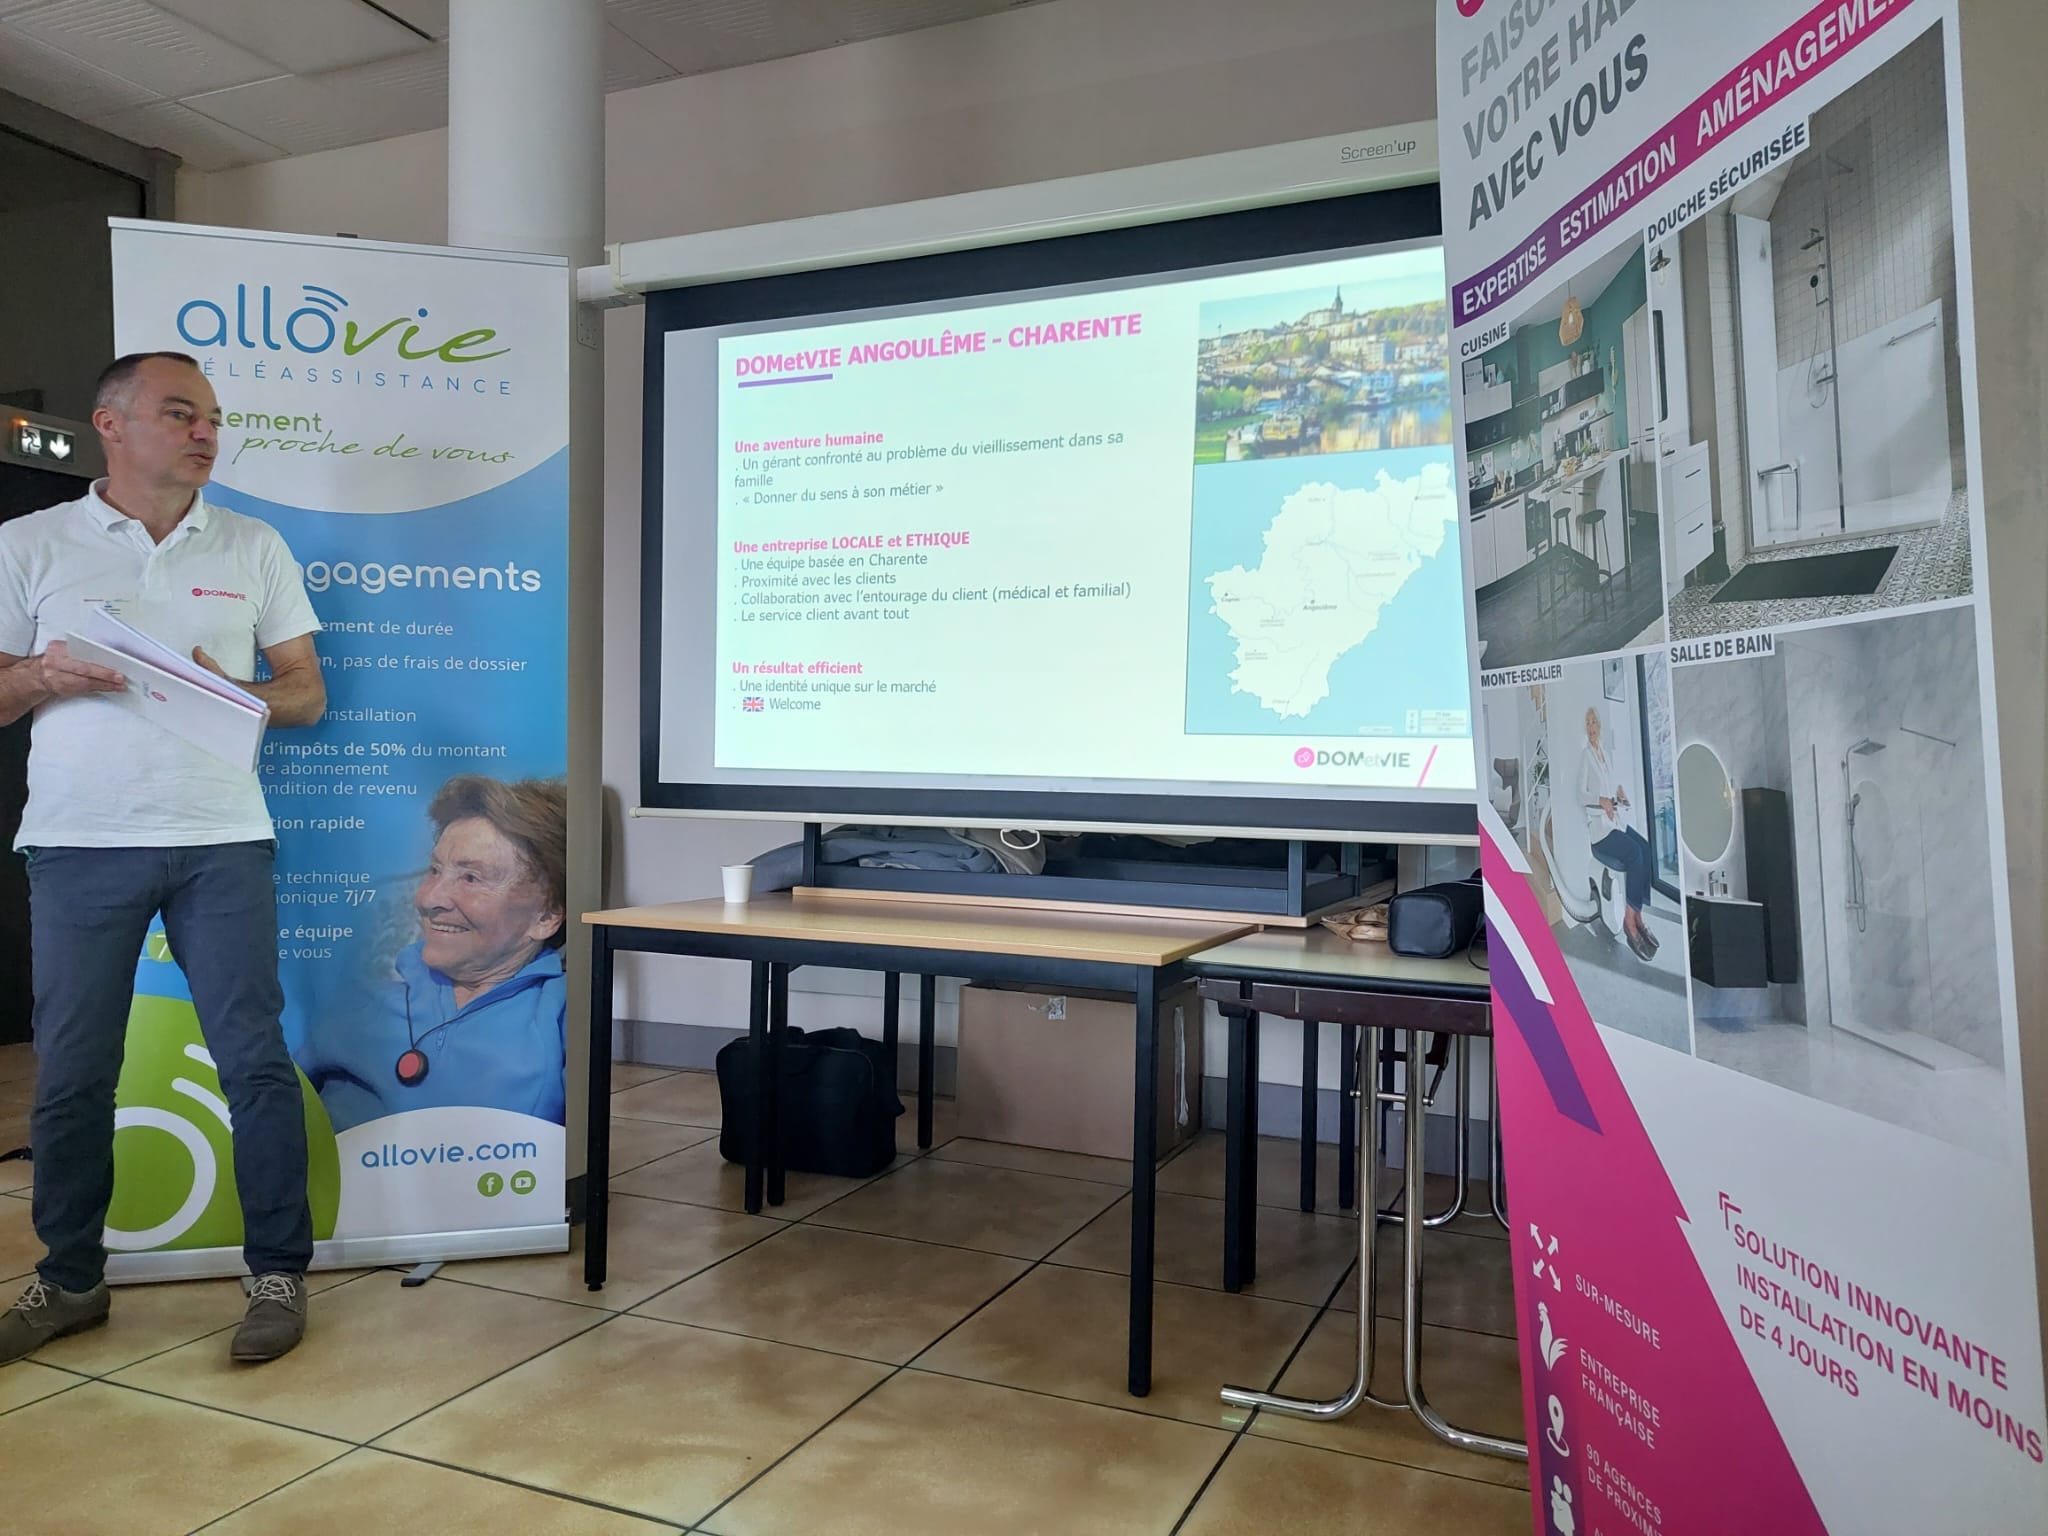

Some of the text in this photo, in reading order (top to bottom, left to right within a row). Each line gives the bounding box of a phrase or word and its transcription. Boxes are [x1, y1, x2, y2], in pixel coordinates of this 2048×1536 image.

[1460, 0, 1553, 98] FAISO
[1462, 0, 1638, 161] VOTRE HA
[1468, 33, 1648, 232] AVEC VOUS
[1341, 139, 1416, 161] Screen'up
[1648, 121, 1806, 244] DOUCHE SÉCURISÉE
[1462, 236, 1547, 316] EXPERTISE
[1559, 135, 1677, 249] ESTIMATION
[177, 283, 511, 363] allovie
[736, 348, 842, 377] DOMetVIE
[848, 329, 986, 366] ANGOULÊME
[1008, 313, 1142, 348] CHARENTE
[1460, 321, 1507, 357] CUISINE
[203, 357, 512, 396] ÉLÉASSISTANCE
[226, 412, 323, 433] ement
[231, 430, 515, 465] proche de vous
[735, 431, 884, 453] Une aventure humaine
[742, 432, 1124, 472] Un gérant confronté au problème du vieillissement dans sa
[734, 474, 774, 489] famille
[753, 491, 797, 505] Donner
[800, 488, 816, 502] du
[819, 489, 848, 501] sens
[851, 485, 860, 499] à
[863, 486, 886, 498] son
[889, 482, 932, 497] métier
[734, 531, 970, 554] Une entreprise LOCALE et ETHIQUE
[741, 553, 928, 572] Une équipe basée en Charente
[741, 572, 897, 588] Proximité avec les clients
[741, 581, 1131, 605] Collaboration avec l'entourage du client (médical et familial)
[741, 607, 910, 622] Le service client avant tout
[320, 620, 454, 636] ement de durée
[1670, 633, 1773, 664] SALLE DE BAIN
[343, 656, 372, 671] pas
[377, 654, 399, 669] de
[404, 655, 440, 670] frais
[444, 656, 464, 671] de
[468, 656, 528, 672] dossier
[732, 661, 863, 674] Un résultat efficient
[739, 679, 936, 695] Une identité unique sur le marché
[1480, 664, 1563, 688] MONTE-ESCALIER
[324, 708, 417, 723] installation
[769, 698, 822, 710] Welcome
[263, 742, 507, 759] d'impôts de 50% du montant
[1317, 750, 1411, 768] DOMetVIE
[257, 762, 389, 776] re abonnement
[260, 781, 417, 796] ondition de revenu
[271, 815, 366, 833] tion rapide
[287, 870, 370, 887] technique
[344, 889, 377, 907] 7j/7
[295, 924, 353, 942] équipe
[292, 947, 332, 960] vous
[361, 1141, 537, 1168] allovie.com
[1575, 1273, 1661, 1350] SUR-MESURE
[1734, 1222, 2009, 1391] SOLUTION INNOVANTE
[1739, 1303, 1860, 1397] DE 4 JOURS
[1736, 1262, 2043, 1465] INSTALLATION EN MOINS
[1580, 1347, 1661, 1429] ENTREPRISE
[1581, 1373, 1656, 1450] FRANÇAISE
[1586, 1443, 1662, 1525] 90 AGENCES
[1588, 1466, 1663, 1536] DE PROXIM
